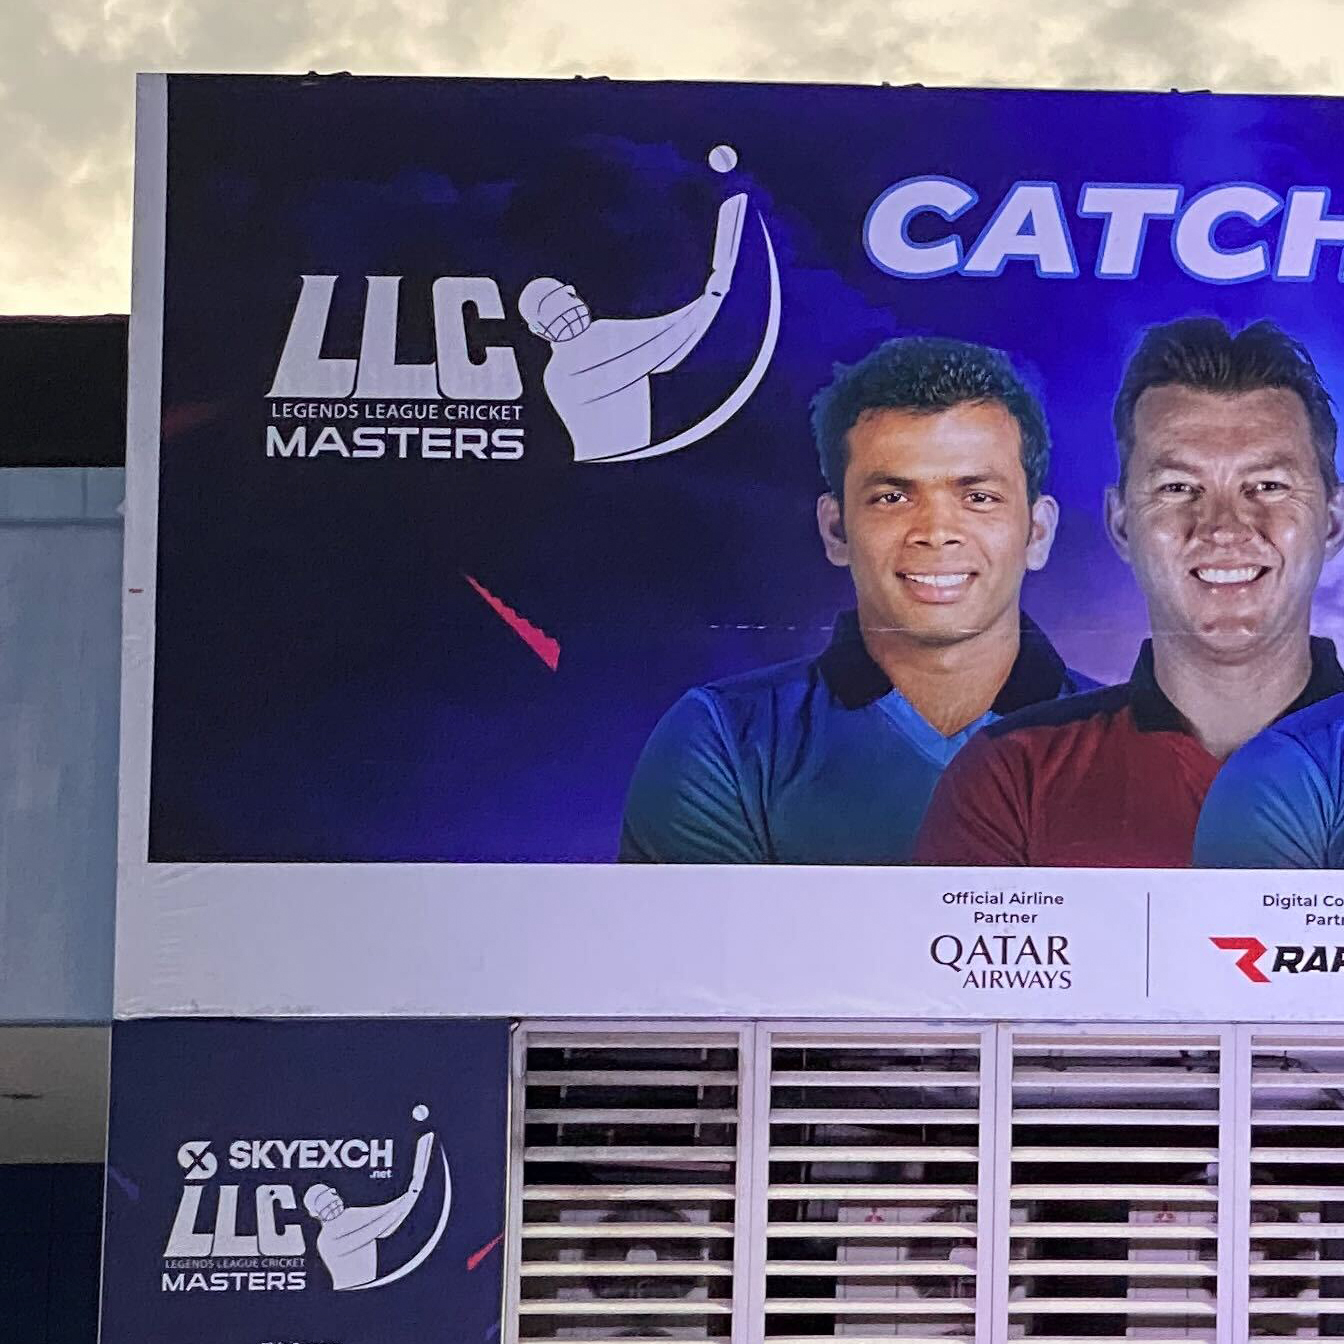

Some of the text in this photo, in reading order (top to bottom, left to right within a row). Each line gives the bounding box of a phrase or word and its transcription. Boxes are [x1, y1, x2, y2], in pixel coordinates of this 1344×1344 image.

[264, 275, 523, 400] LLC
[271, 403, 523, 421] LEGENDS LEAGUE CRICKET
[265, 426, 525, 460] MASTERS
[942, 891, 1065, 907] Official Airline
[1262, 894, 1318, 911] Digital
[973, 910, 1038, 925] Partner
[930, 933, 1072, 973] QATAR
[962, 969, 1073, 990] AIRWAYS
[228, 1138, 394, 1169] SKYEXCH
[163, 1184, 307, 1258] LLC
[164, 1256, 305, 1270] LEGENDS LEAGUE CRICKET
[161, 1271, 307, 1292] MASTERS
